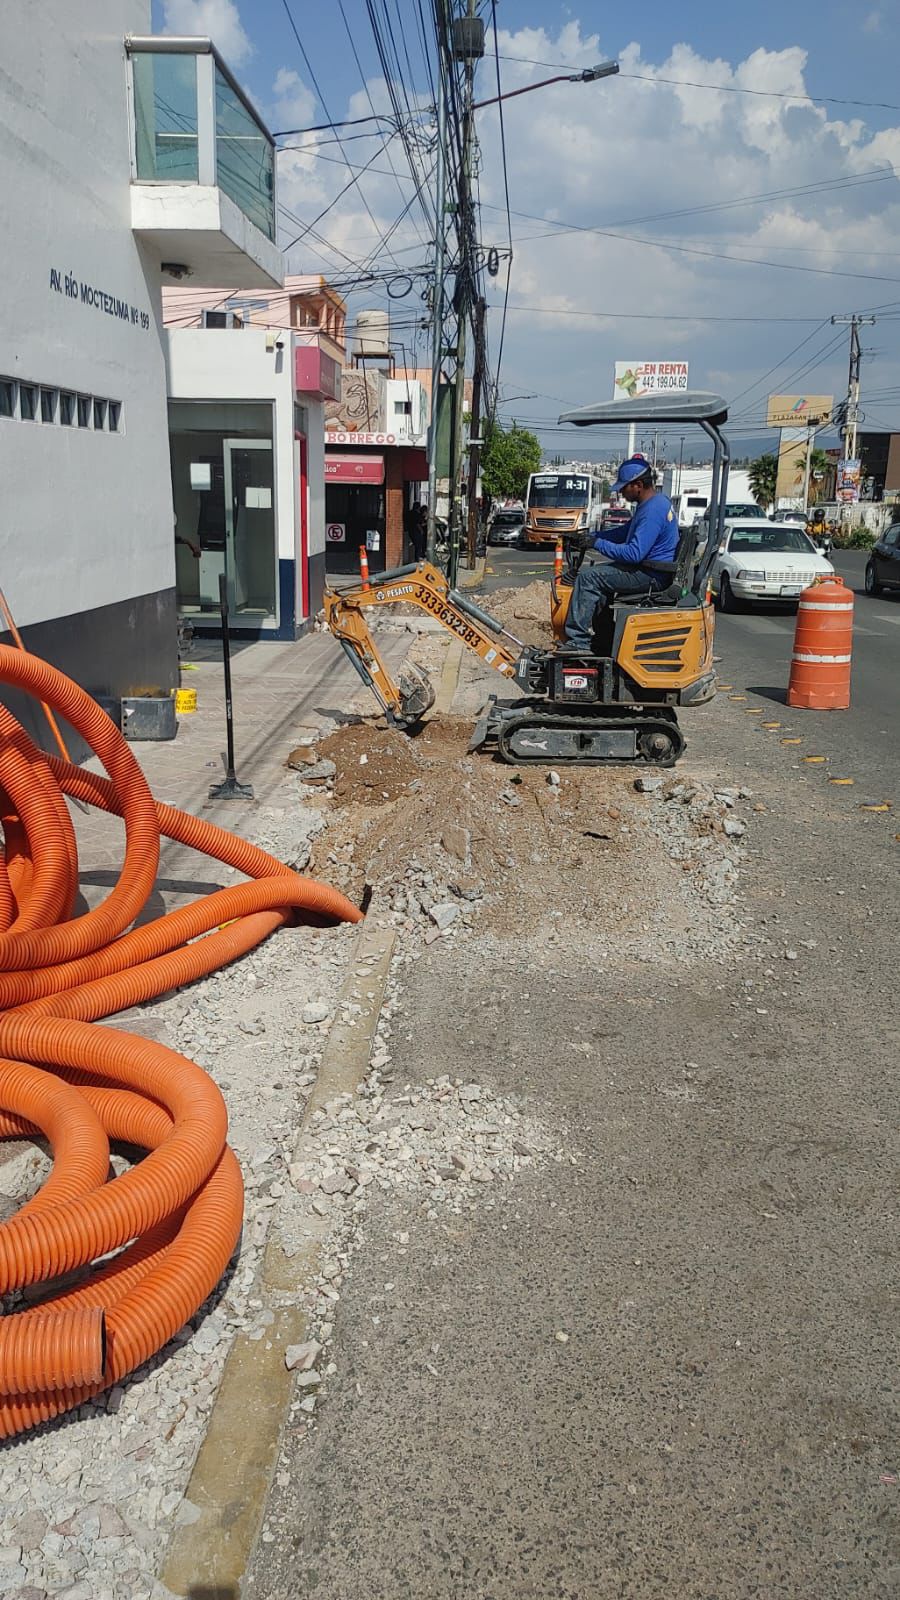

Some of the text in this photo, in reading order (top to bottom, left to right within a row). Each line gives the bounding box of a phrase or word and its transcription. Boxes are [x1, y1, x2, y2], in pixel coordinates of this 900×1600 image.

[50, 268, 62, 294] AV.
[65, 270, 79, 299] RÍO
[80, 282, 130, 322] MOCTEZUMA
[644, 363, 688, 375] EN RENTA
[642, 375, 655, 388] 442
[327, 432, 396, 444] BORREGO
[566, 479, 587, 491] R-31
[415, 587, 482, 648] 3333632383
